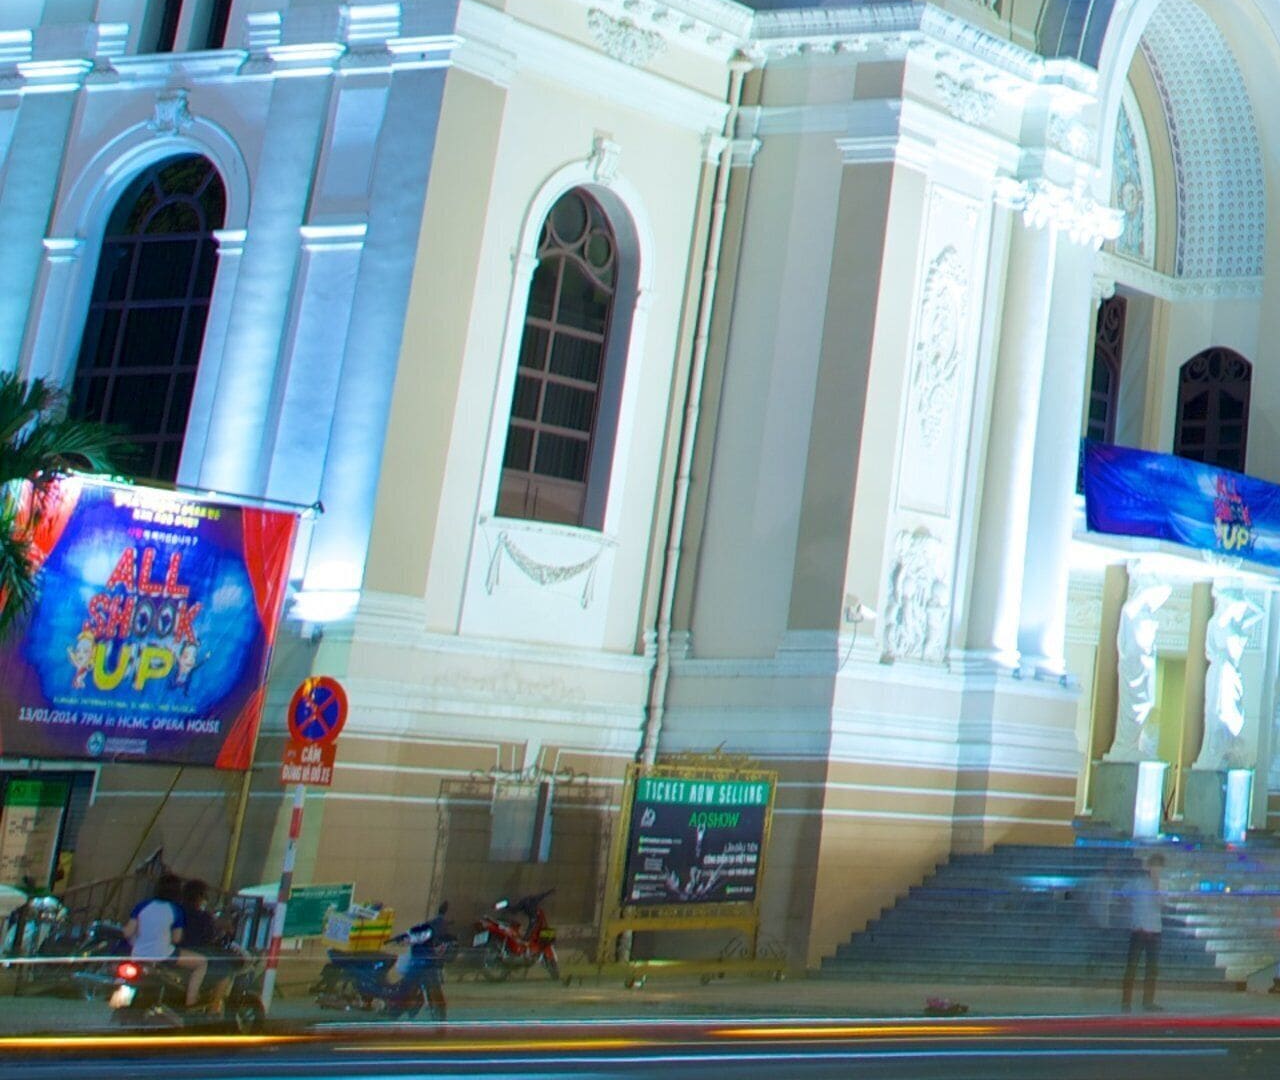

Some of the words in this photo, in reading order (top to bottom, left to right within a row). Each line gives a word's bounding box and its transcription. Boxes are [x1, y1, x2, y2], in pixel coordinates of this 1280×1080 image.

[1221, 523, 1249, 551] UP
[106, 546, 190, 599] ALL
[82, 592, 203, 644] SHOOK
[93, 642, 175, 691] UP
[80, 712, 103, 726] 7PM
[118, 716, 149, 731] HCMC
[153, 718, 185, 732] OPERA
[187, 719, 221, 734] HOUSE
[645, 780, 685, 802] TICKET
[688, 782, 715, 804] NOW
[719, 784, 764, 806] SELLING
